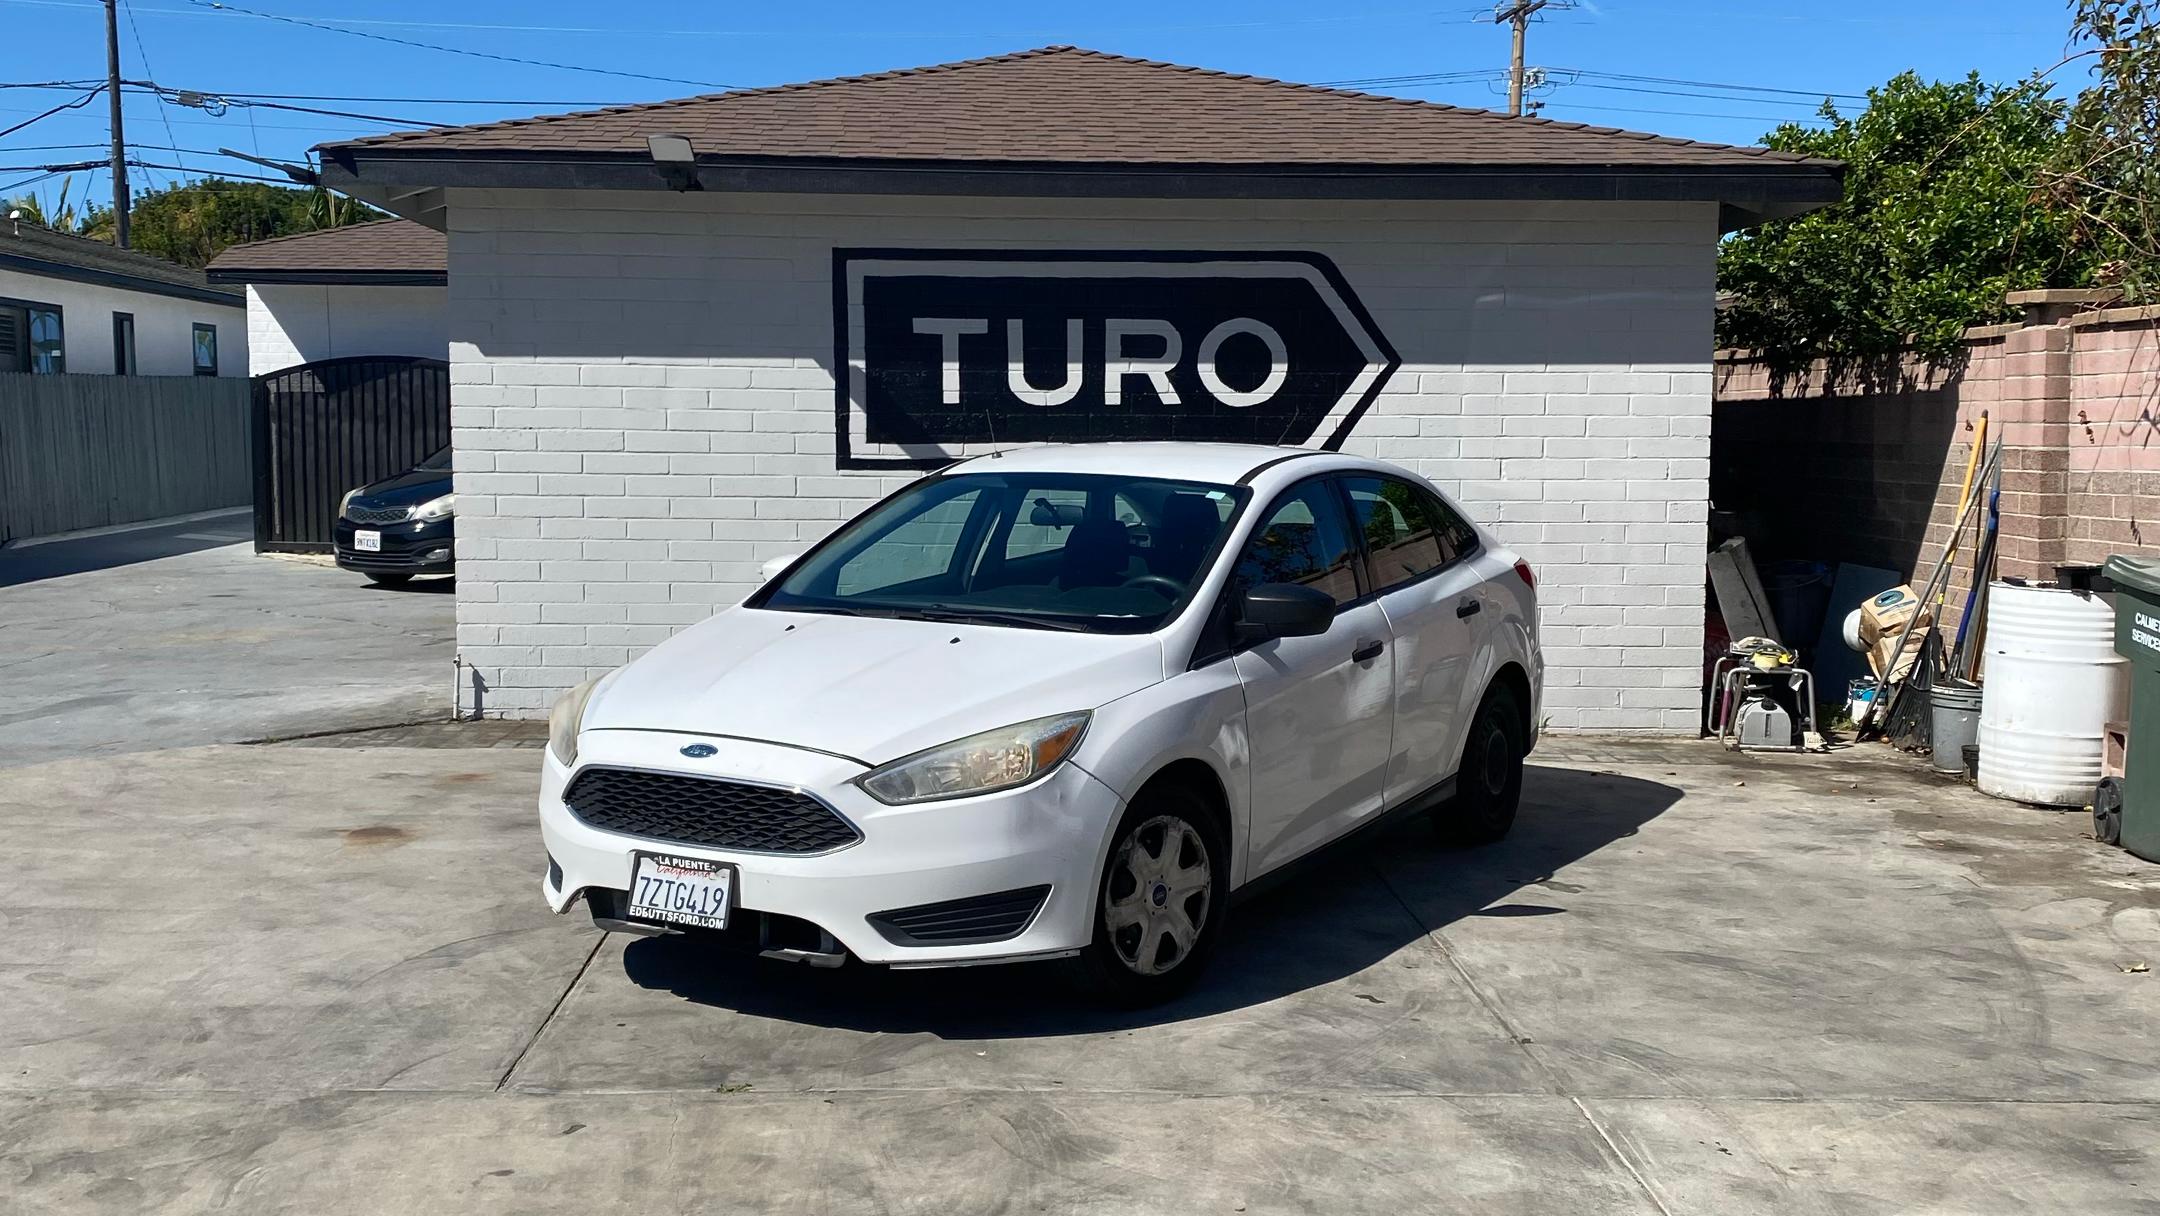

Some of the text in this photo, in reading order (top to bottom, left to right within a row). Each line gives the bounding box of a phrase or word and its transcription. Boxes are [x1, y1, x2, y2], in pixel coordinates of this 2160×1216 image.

[912, 317, 1288, 407] TURO
[2135, 612, 2160, 633] CALME
[2132, 628, 2160, 652] SERVICE
[658, 855, 711, 871] LA PUENTE
[638, 876, 725, 916] 7ZTG419
